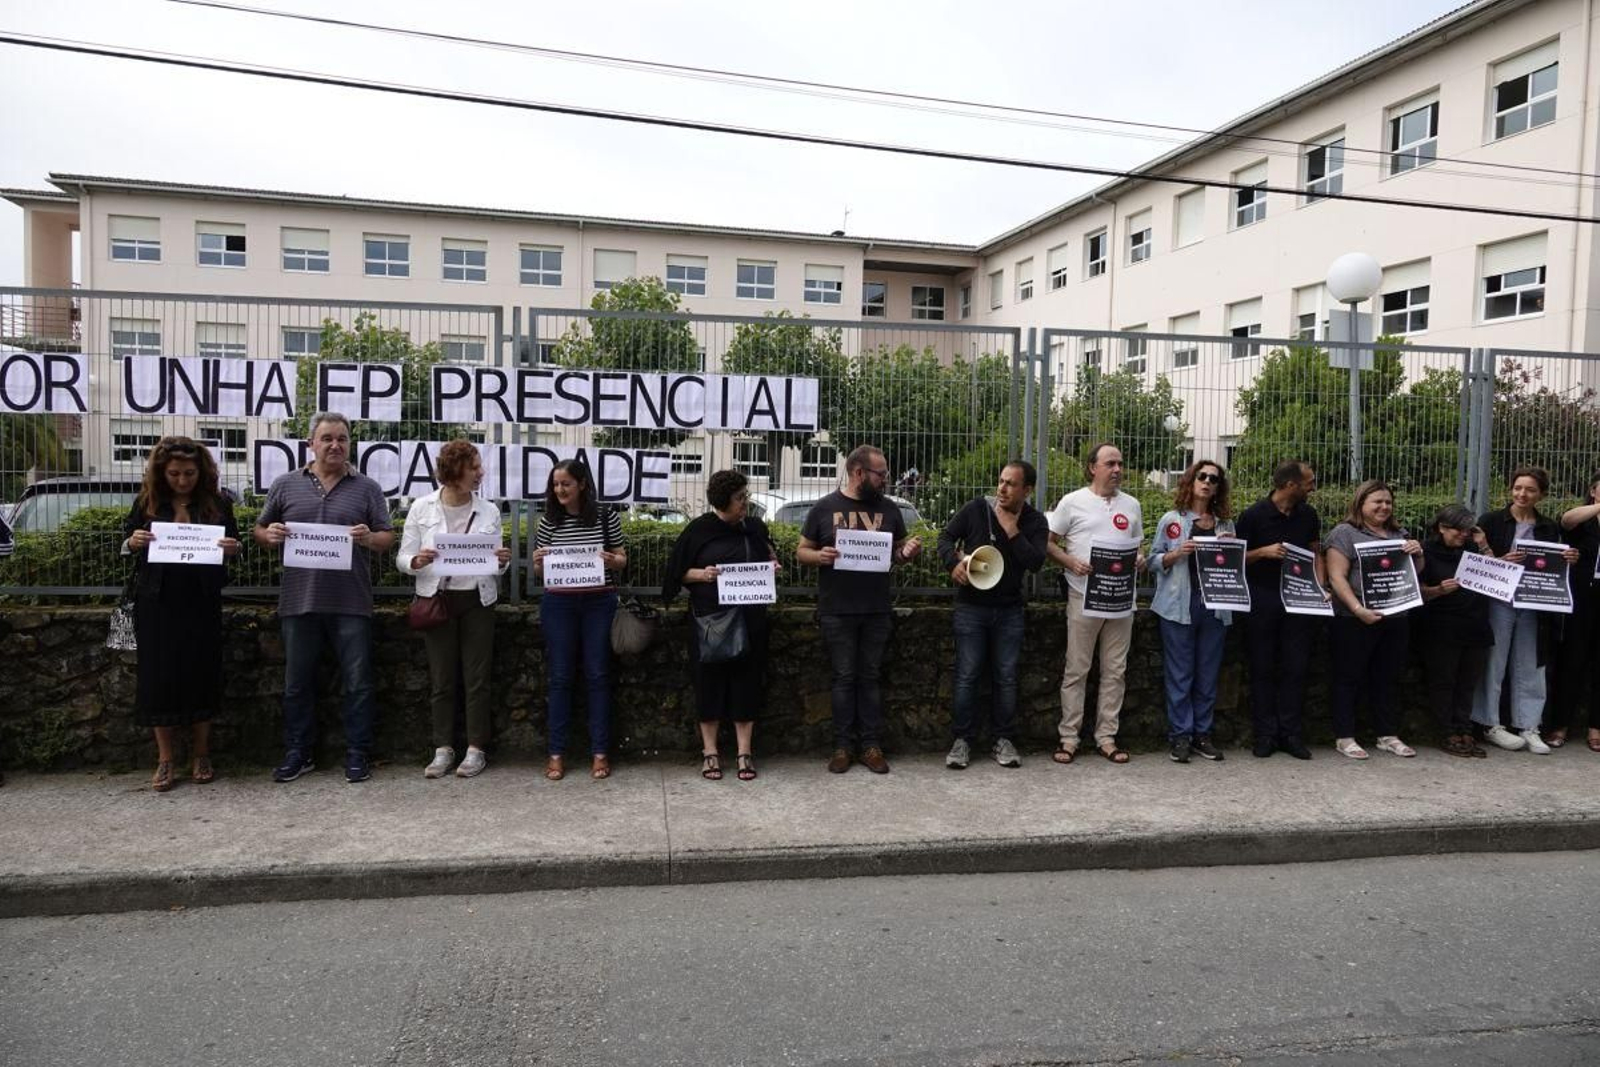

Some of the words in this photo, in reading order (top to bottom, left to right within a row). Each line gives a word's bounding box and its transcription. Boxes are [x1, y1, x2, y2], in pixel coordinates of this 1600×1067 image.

[124, 356, 294, 418] UNHA
[319, 363, 400, 419] FP
[433, 367, 814, 431] PRESENCIAL
[254, 440, 313, 494] D
[300, 533, 349, 543] TRANSPORTE
[848, 539, 889, 548] TRANSPORTE
[295, 549, 341, 558] PRESENCIAL
[549, 548, 564, 556] POR
[564, 547, 586, 555] UNHA
[180, 553, 194, 561] FP
[443, 557, 487, 565] PRESENCIAL
[843, 553, 881, 561] PRESENCIAL
[551, 562, 596, 570] PRESENCIAL
[1467, 554, 1483, 563] POR
[1484, 559, 1506, 570] UNHA
[1507, 564, 1519, 572] FP
[738, 565, 759, 573] UNHA
[1465, 566, 1510, 585] PRESENCIAL
[565, 576, 602, 585] CALIDADE
[724, 579, 767, 587] PRESENCIAL
[1462, 579, 1473, 587] DE
[1473, 582, 1510, 598] CALIDADE
